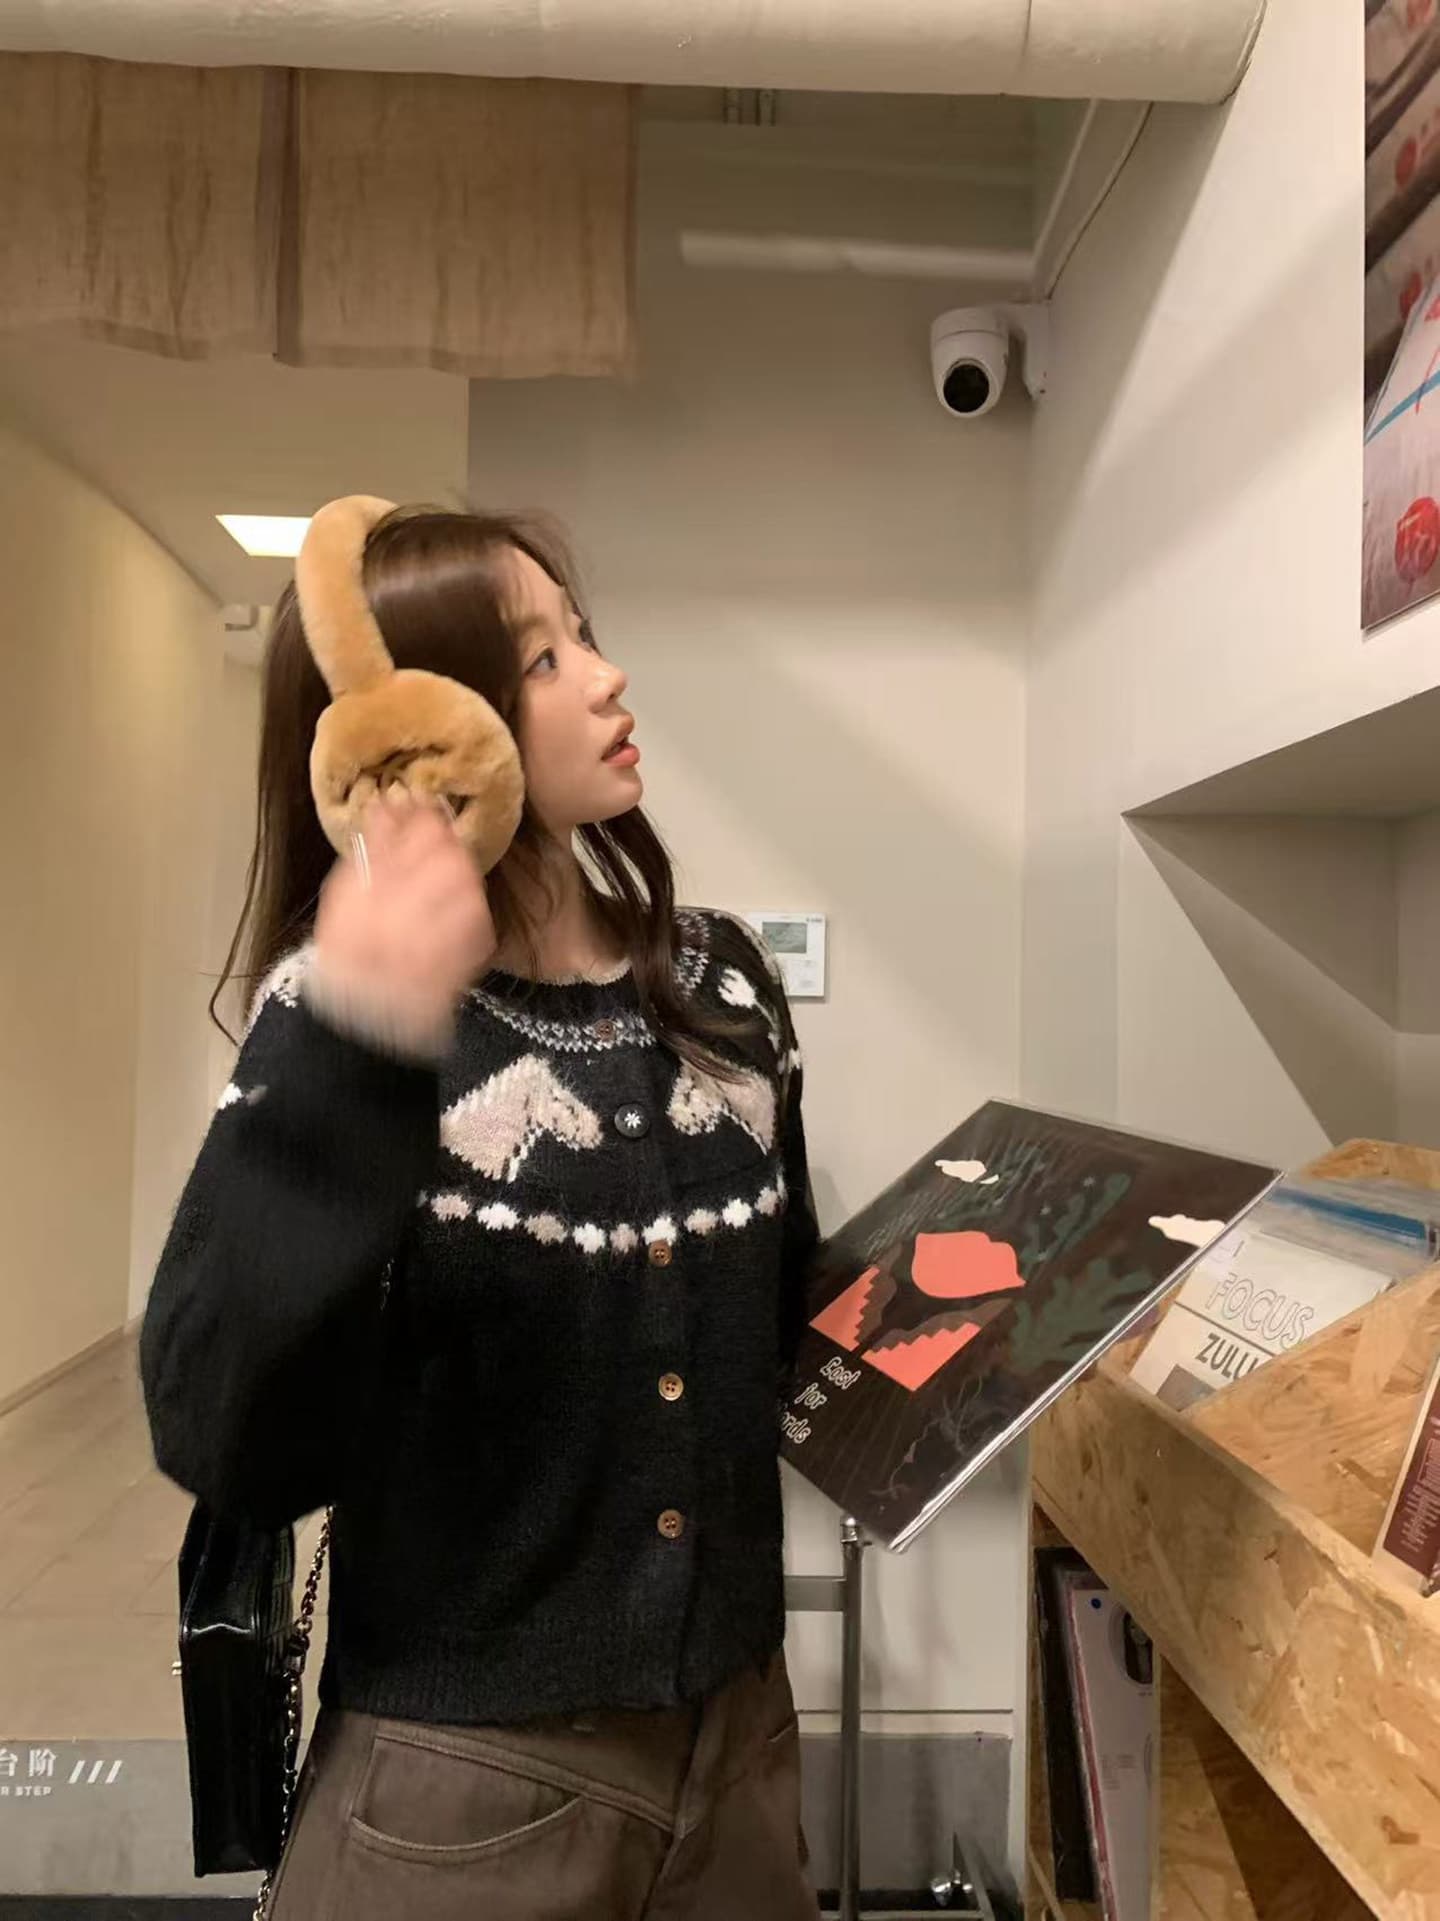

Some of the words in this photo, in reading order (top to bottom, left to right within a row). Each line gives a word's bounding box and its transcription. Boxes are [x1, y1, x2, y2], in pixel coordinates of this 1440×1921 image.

[1205, 1272, 1315, 1350] FOCUS
[820, 1356, 861, 1390] Lost
[794, 1382, 827, 1410] for
[15, 1785, 52, 1797] STEP
